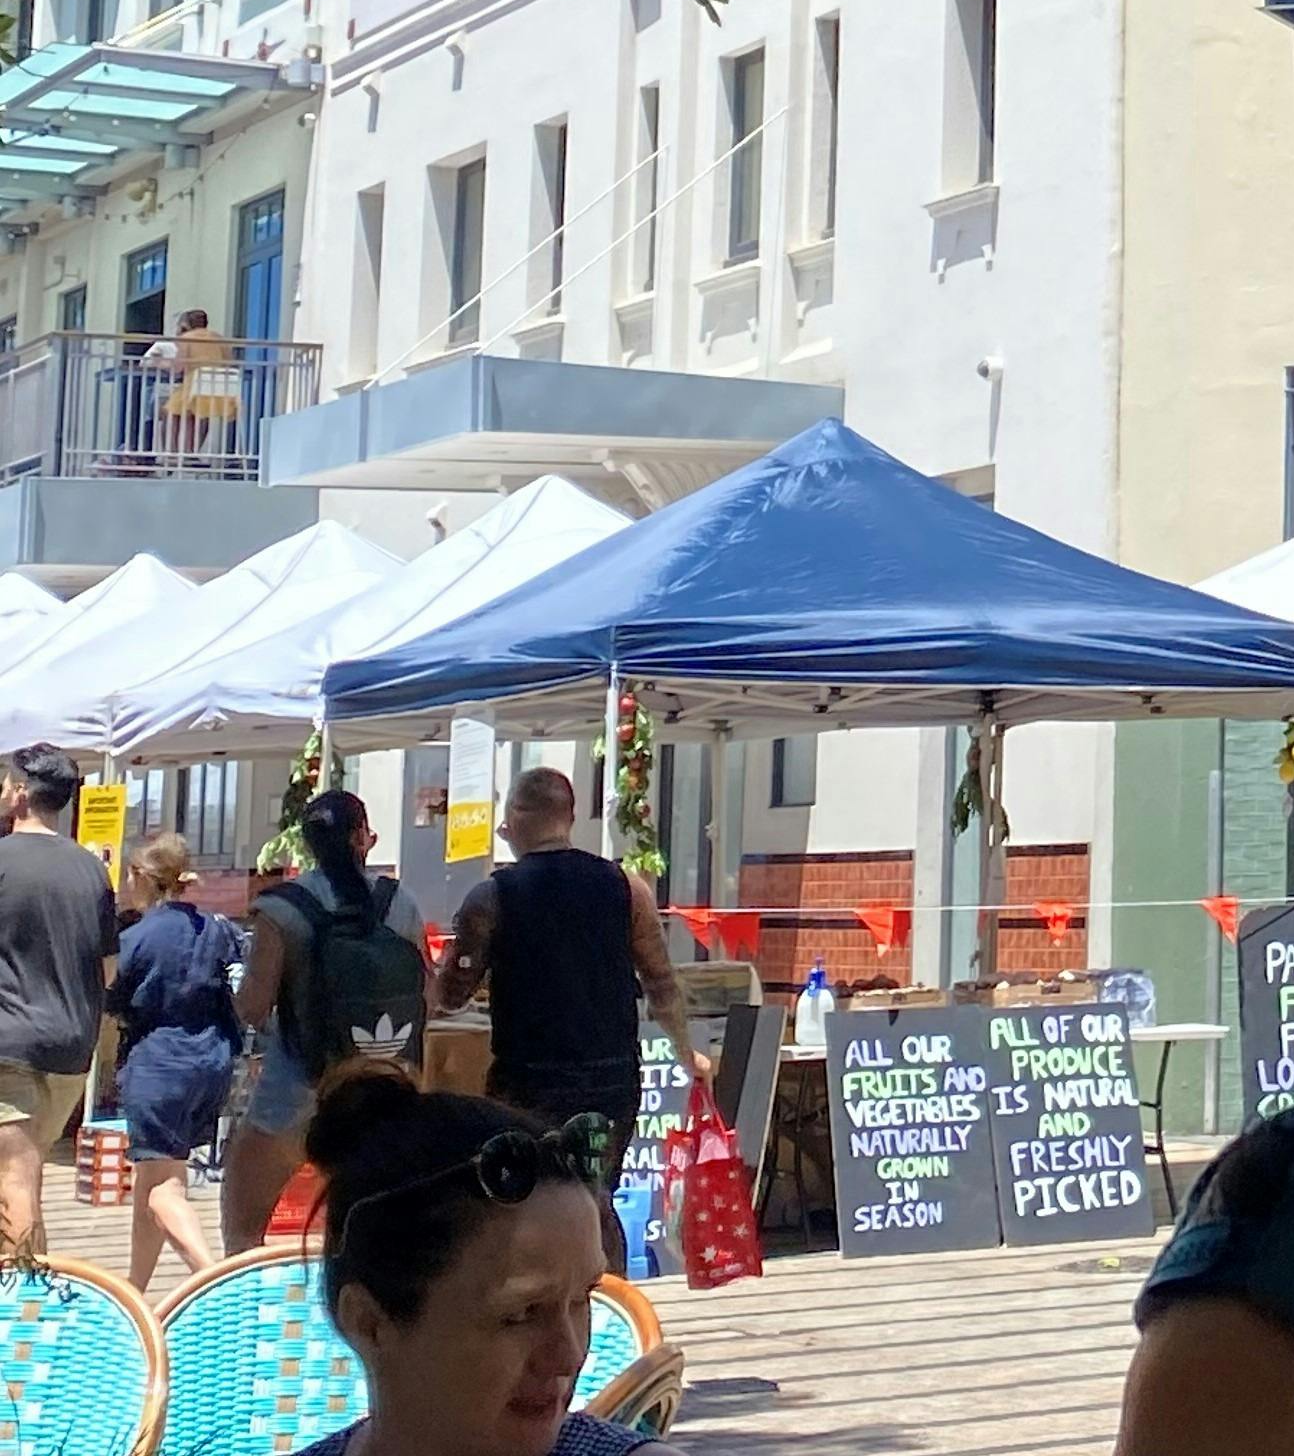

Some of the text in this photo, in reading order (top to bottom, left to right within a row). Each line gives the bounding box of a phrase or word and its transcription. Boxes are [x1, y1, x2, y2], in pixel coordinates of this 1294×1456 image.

[989, 1013, 1126, 1050] ALL OF OUR
[845, 1034, 953, 1069] ALL OUR
[1010, 1045, 1128, 1082] PRODUCE
[842, 1066, 987, 1100] FRUITS AND
[991, 1078, 1140, 1116] IS NATURAL
[844, 1093, 982, 1128] VEGETABLES
[1038, 1111, 1092, 1140] AND
[850, 1124, 973, 1158] NATURALLY
[1009, 1134, 1132, 1177] FRESHLY
[875, 1155, 950, 1181] GROWN
[884, 1180, 920, 1204] IN
[1012, 1169, 1143, 1218] PICKED
[853, 1201, 944, 1233] SEASON
